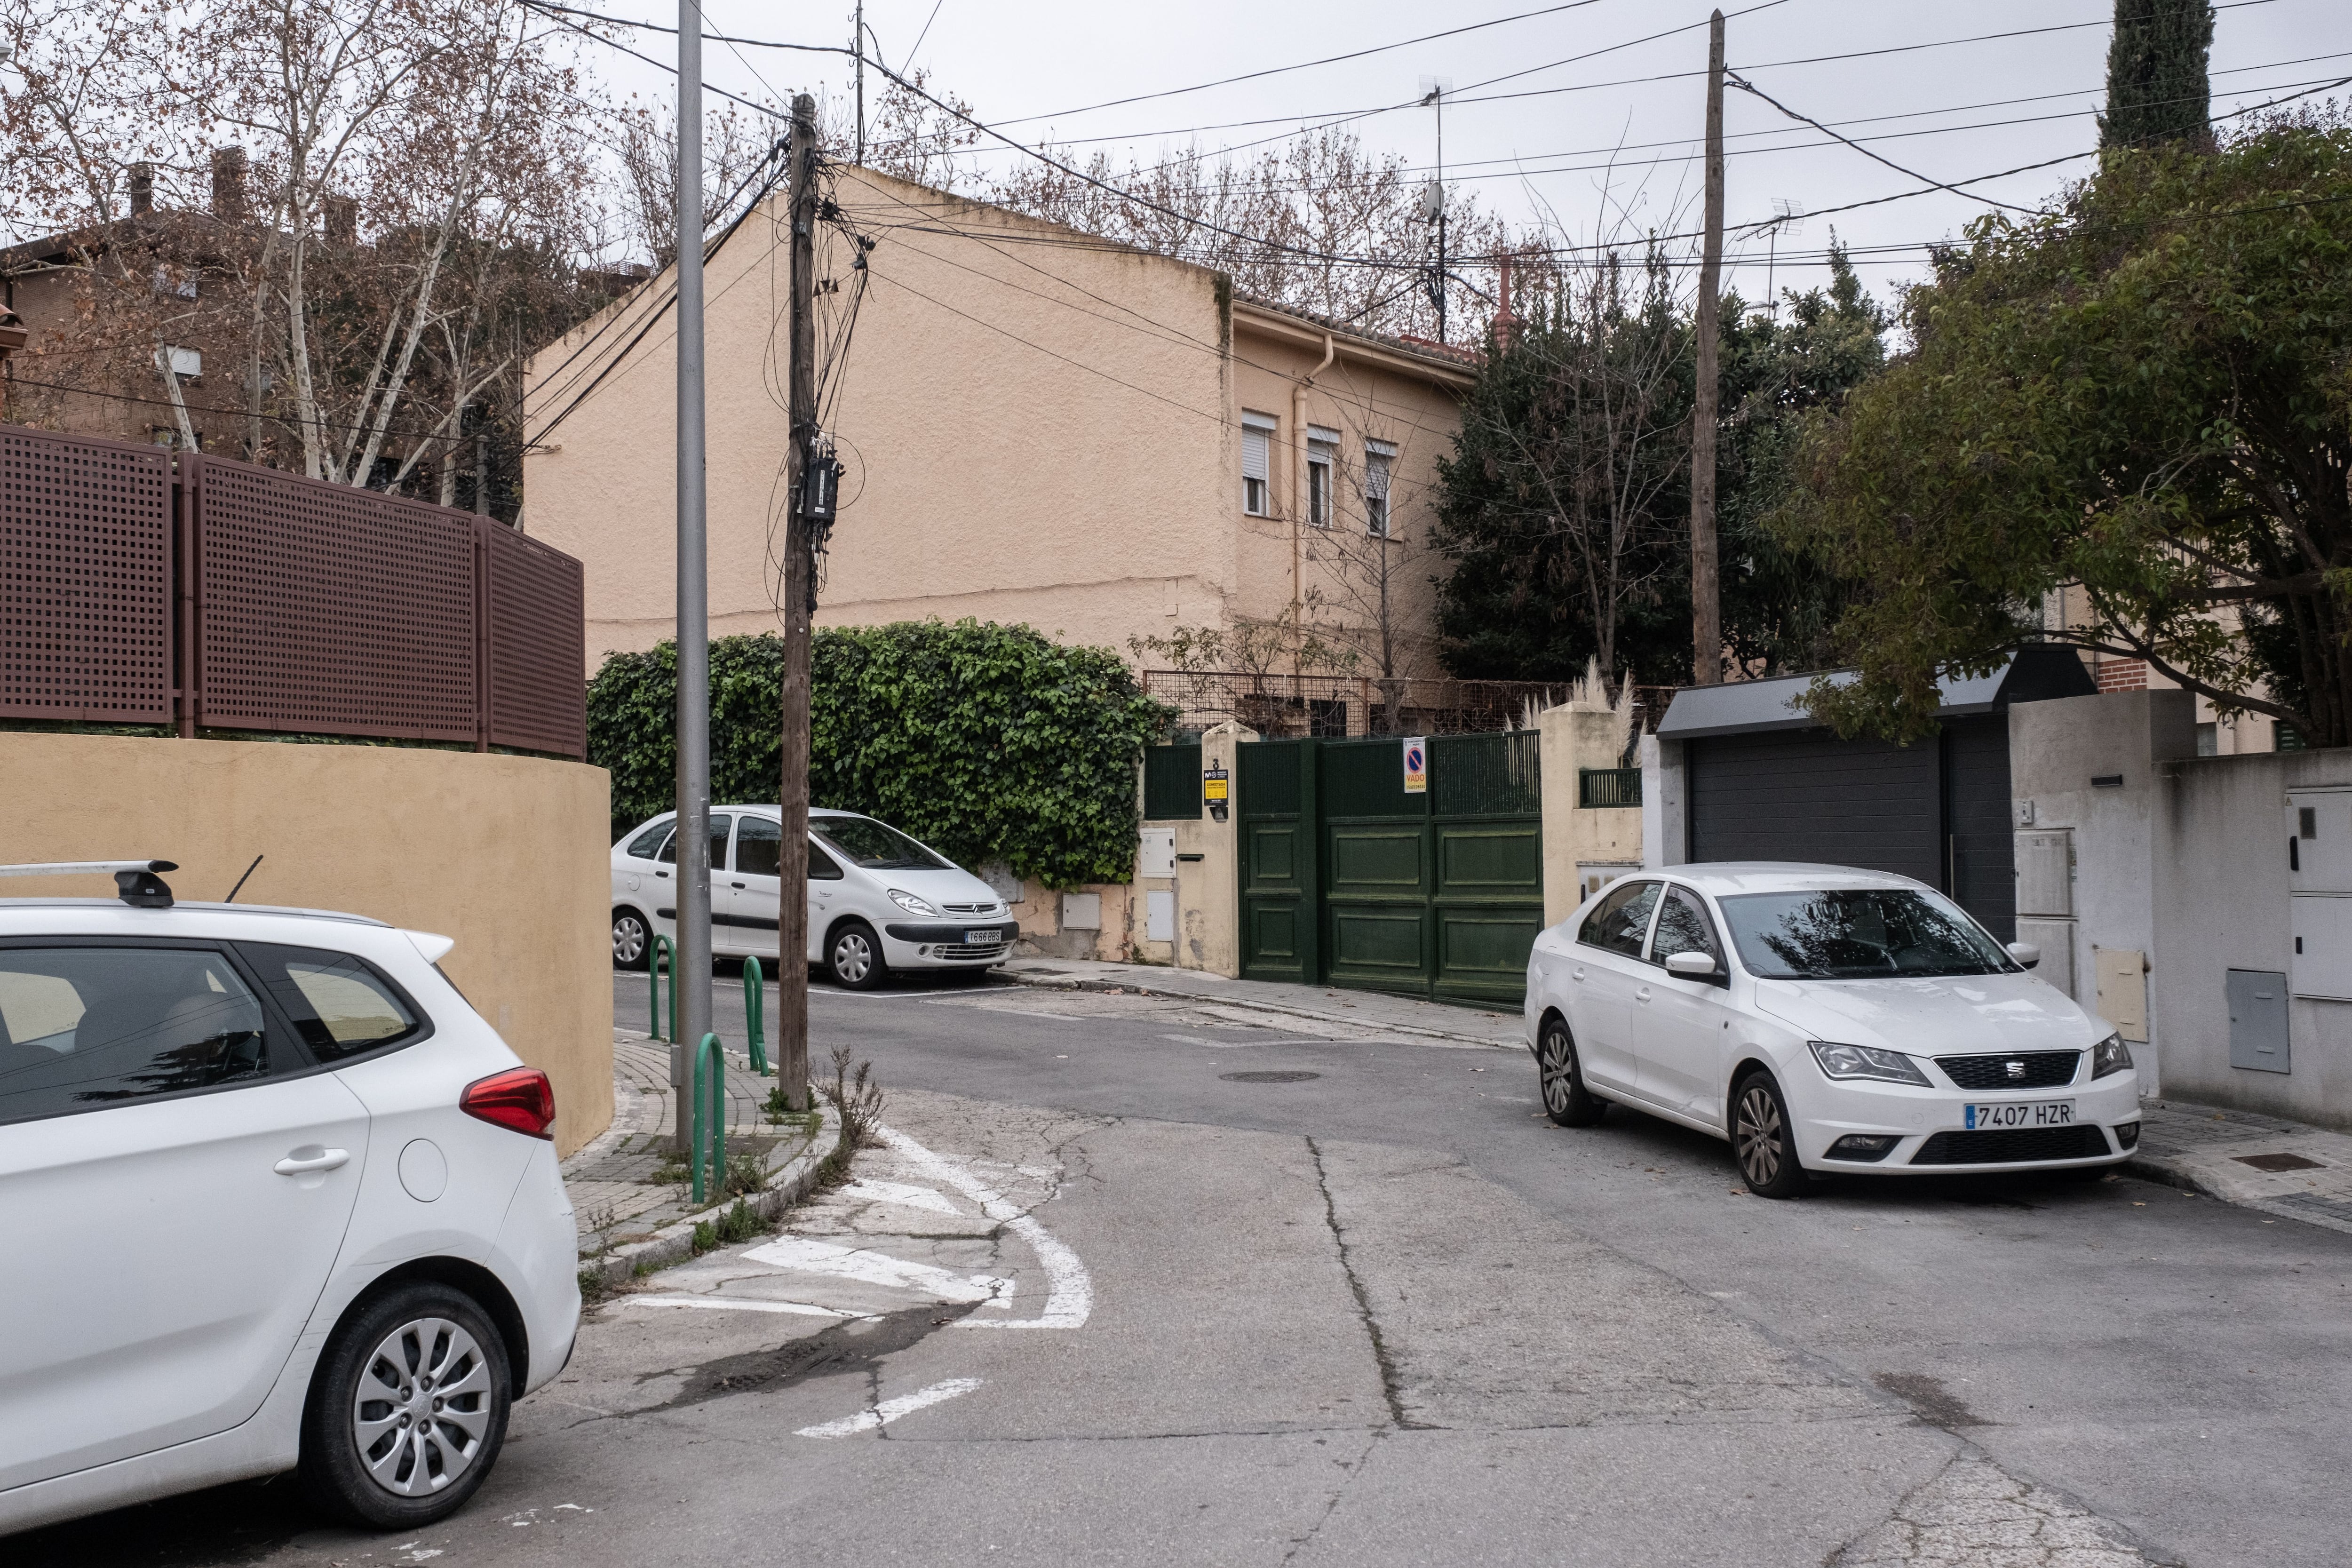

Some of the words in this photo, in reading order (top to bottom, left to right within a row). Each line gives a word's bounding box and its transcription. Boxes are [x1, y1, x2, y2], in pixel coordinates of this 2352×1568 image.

[1213, 758, 1219, 770] 3
[970, 932, 987, 942] 1666
[988, 931, 1000, 941] BBS
[1979, 1106, 2028, 1126] 7407
[2036, 1105, 2070, 1124] HZR
